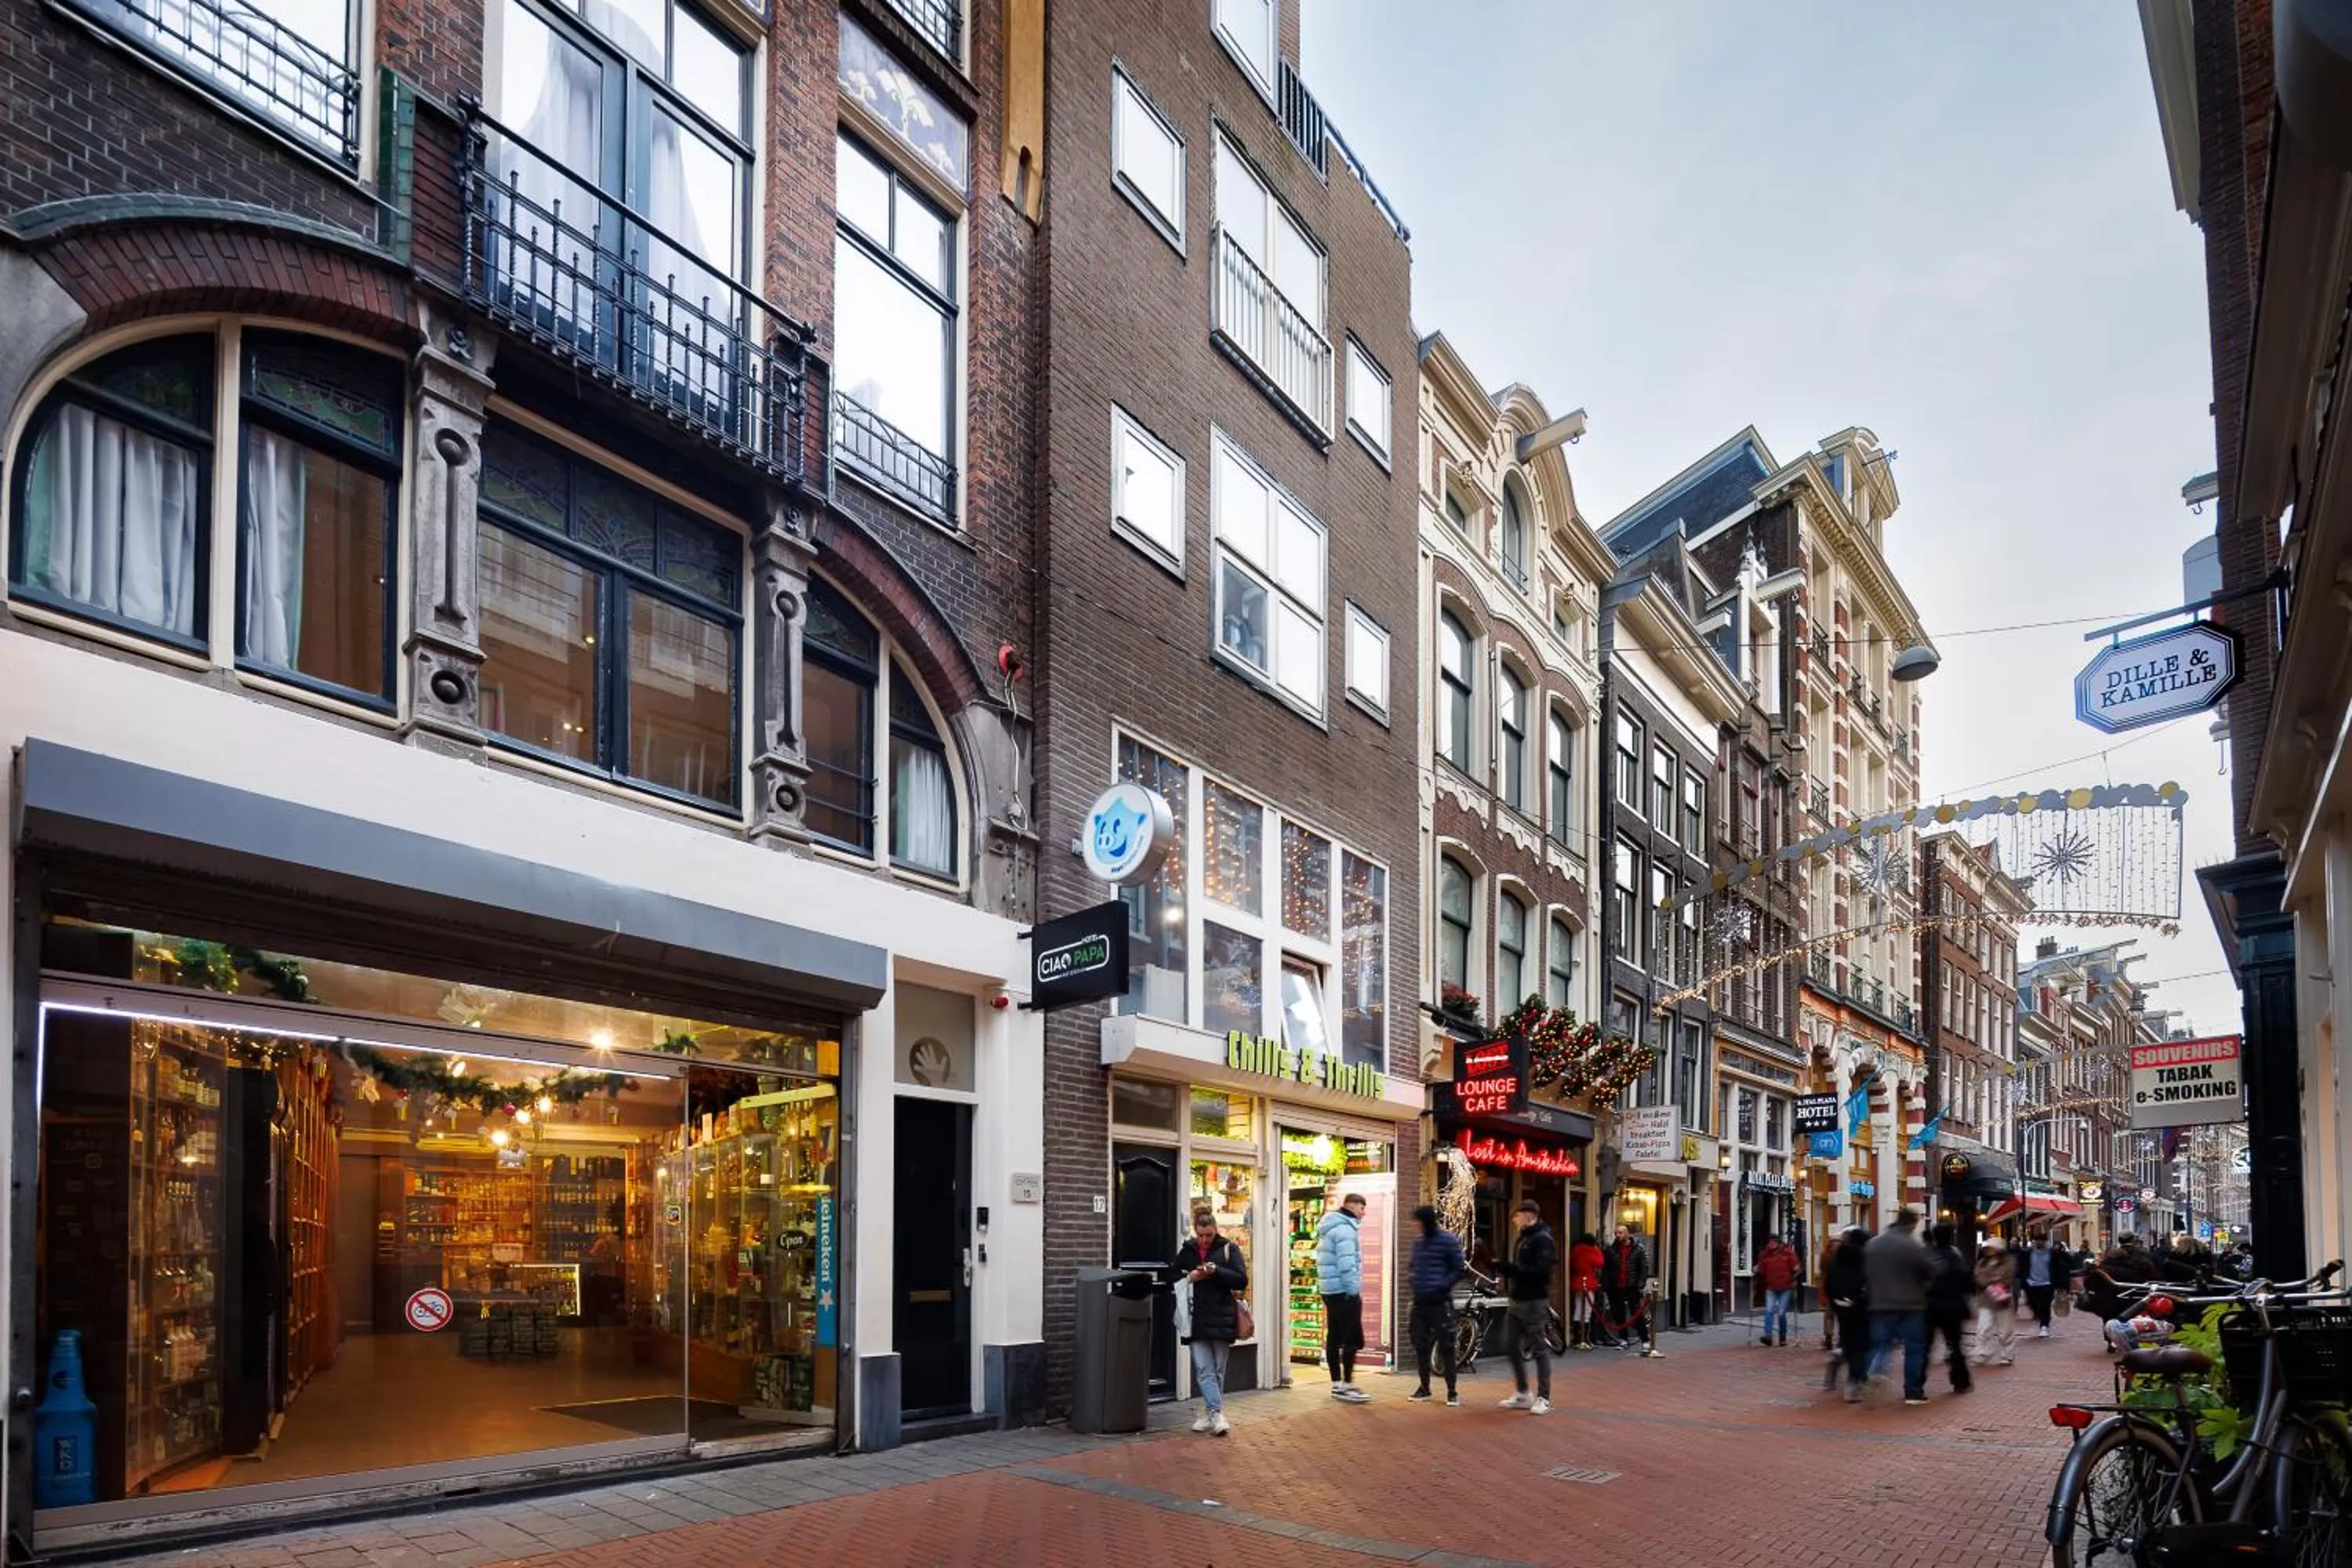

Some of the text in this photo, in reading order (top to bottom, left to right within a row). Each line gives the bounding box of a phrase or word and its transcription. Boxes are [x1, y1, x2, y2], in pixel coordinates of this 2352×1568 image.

[2107, 648, 2209, 689] DILLE &
[2100, 663, 2217, 709] KAMILLE
[1041, 953, 1072, 975] CIAO
[1073, 944, 1105, 967] PAPA
[1229, 1029, 1385, 1100] Chills & Thrills
[2134, 1040, 2234, 1065] SOUVENIRS
[2156, 1064, 2213, 1083] TABAK
[1456, 1078, 1517, 1096] LOUNGE
[2136, 1080, 2237, 1103] e-SMOKING
[1465, 1096, 1506, 1112] CAFE
[1796, 1105, 1836, 1119] HOTEL
[1466, 1129, 1495, 1160] Lost
[1094, 1197, 1105, 1211] 17
